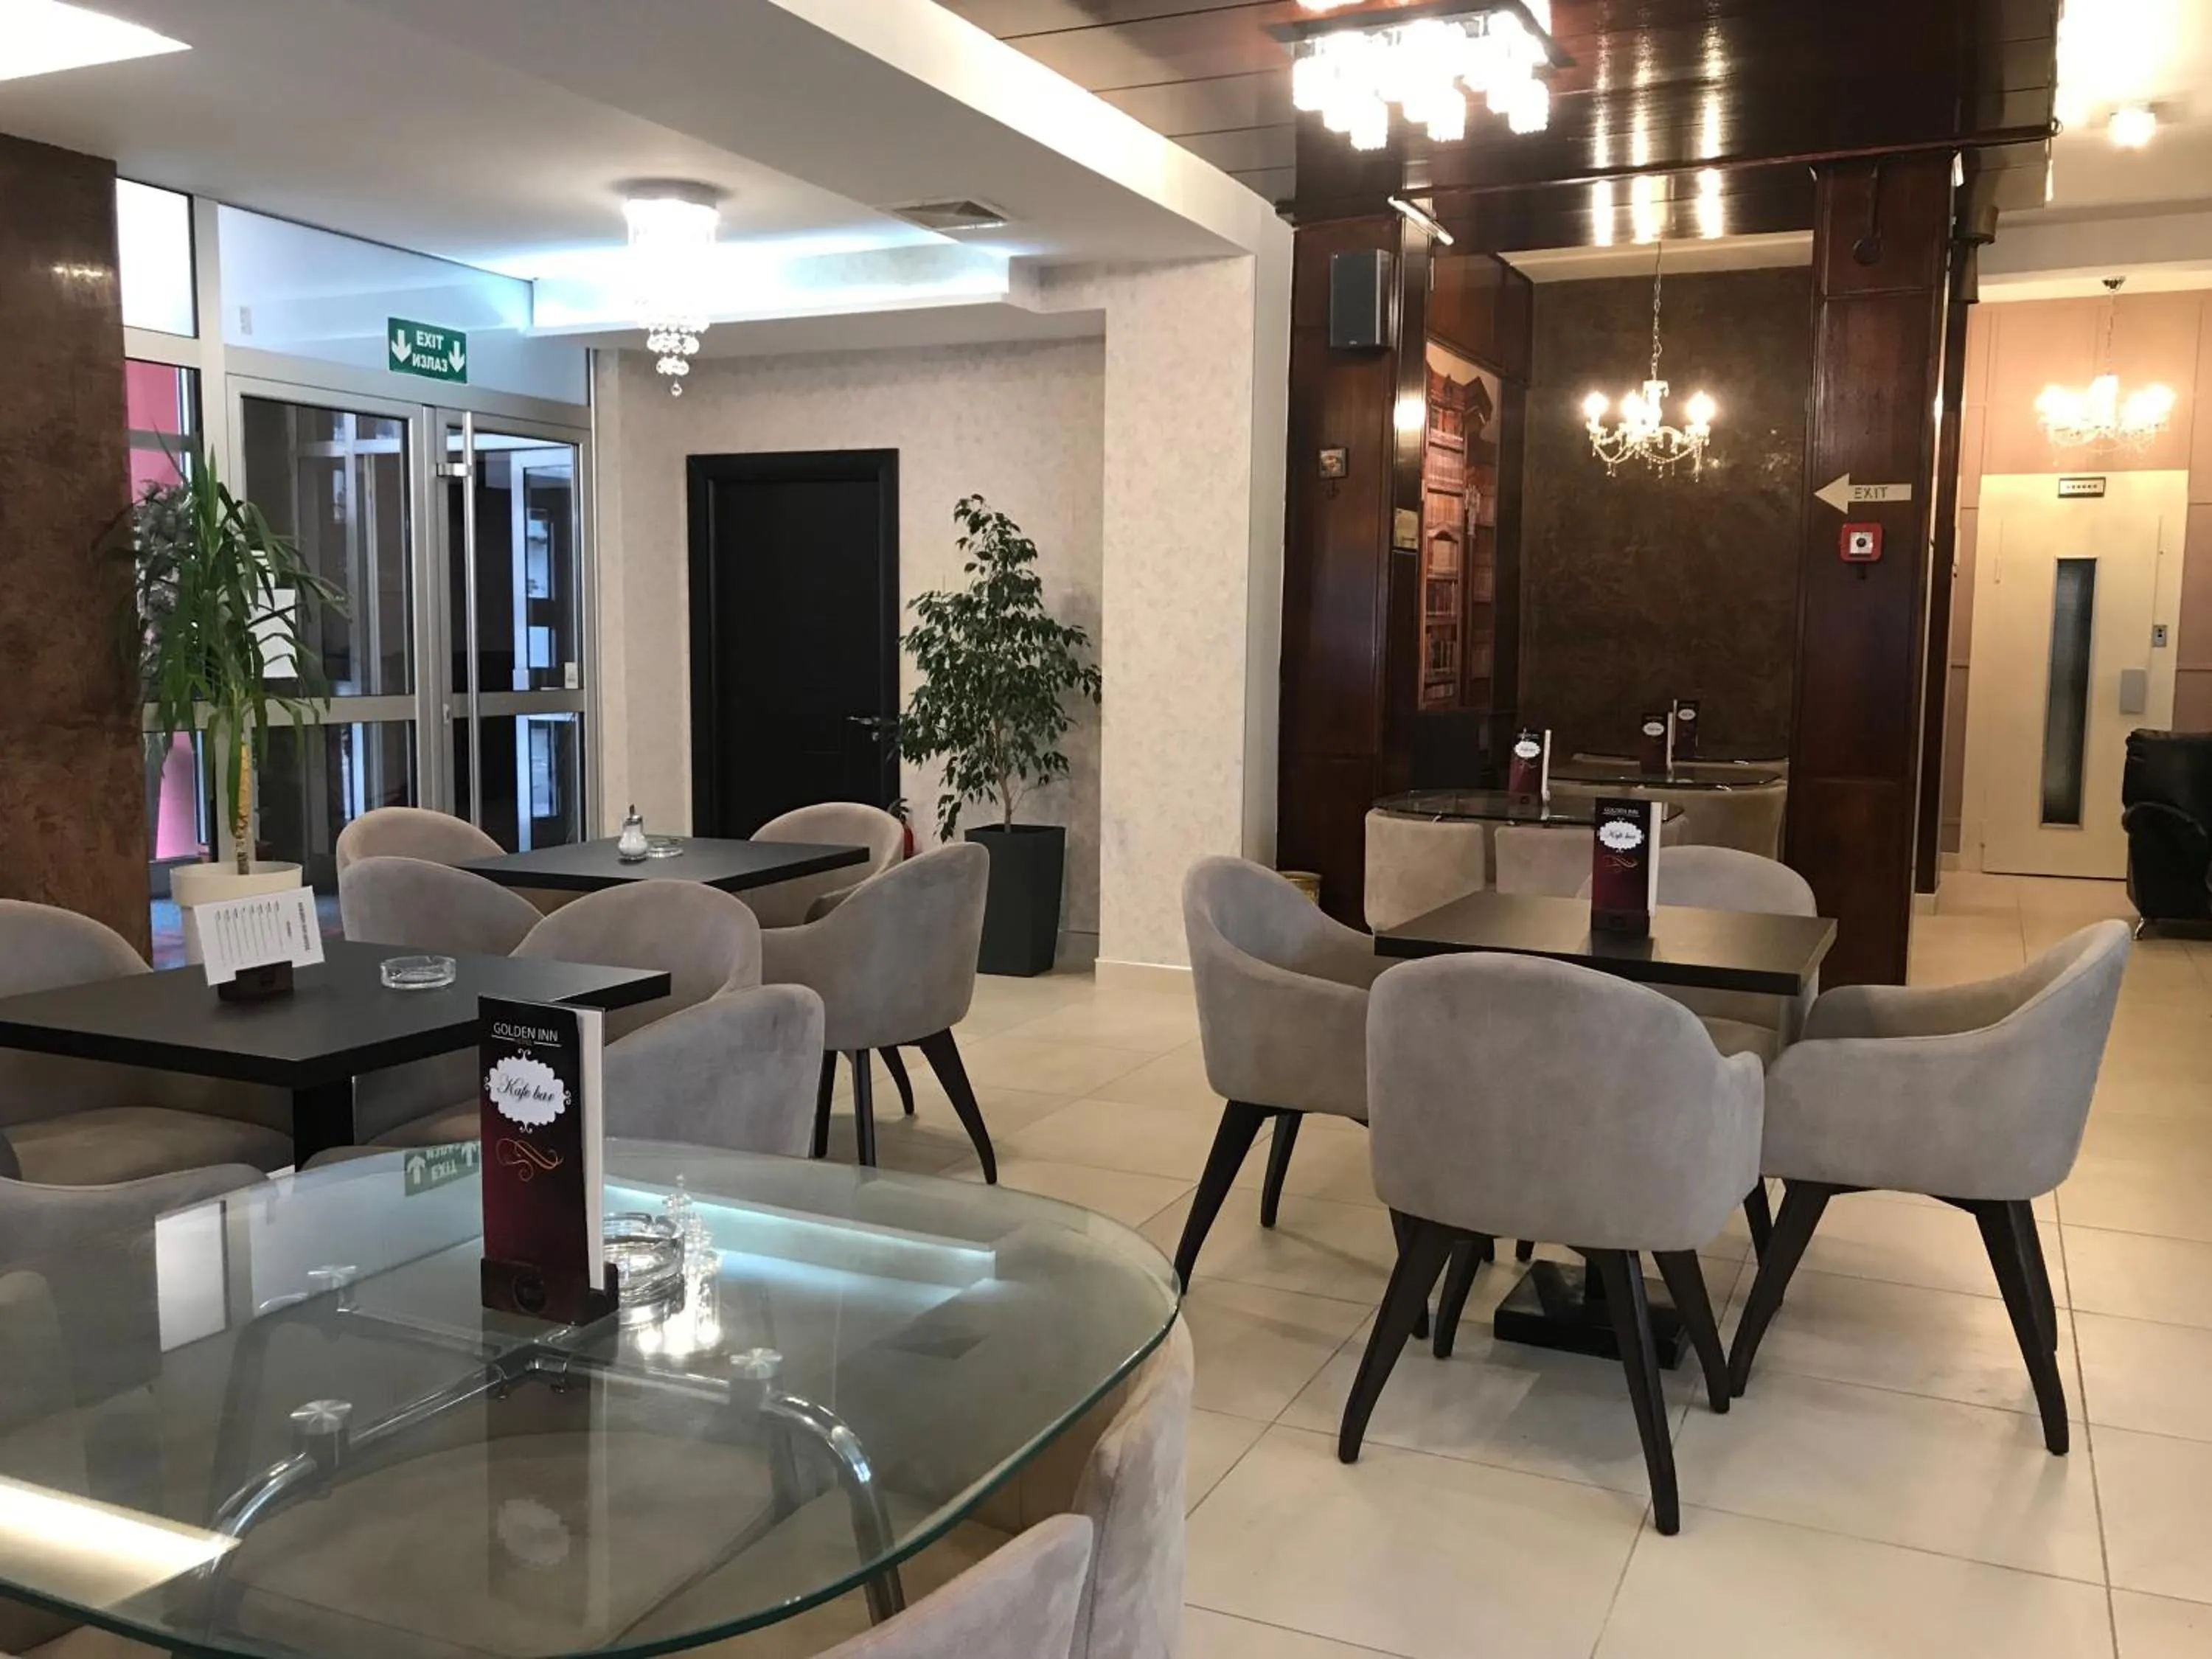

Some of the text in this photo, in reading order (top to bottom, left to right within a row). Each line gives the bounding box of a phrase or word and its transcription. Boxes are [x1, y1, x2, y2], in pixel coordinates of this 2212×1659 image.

[416, 330, 444, 350] EXIT
[412, 352, 448, 372] ИЗЛАЗ
[1854, 487, 1888, 499] EXIT
[493, 1022, 558, 1041] GOLDEN INN
[497, 1075, 555, 1102] Kafe bar
